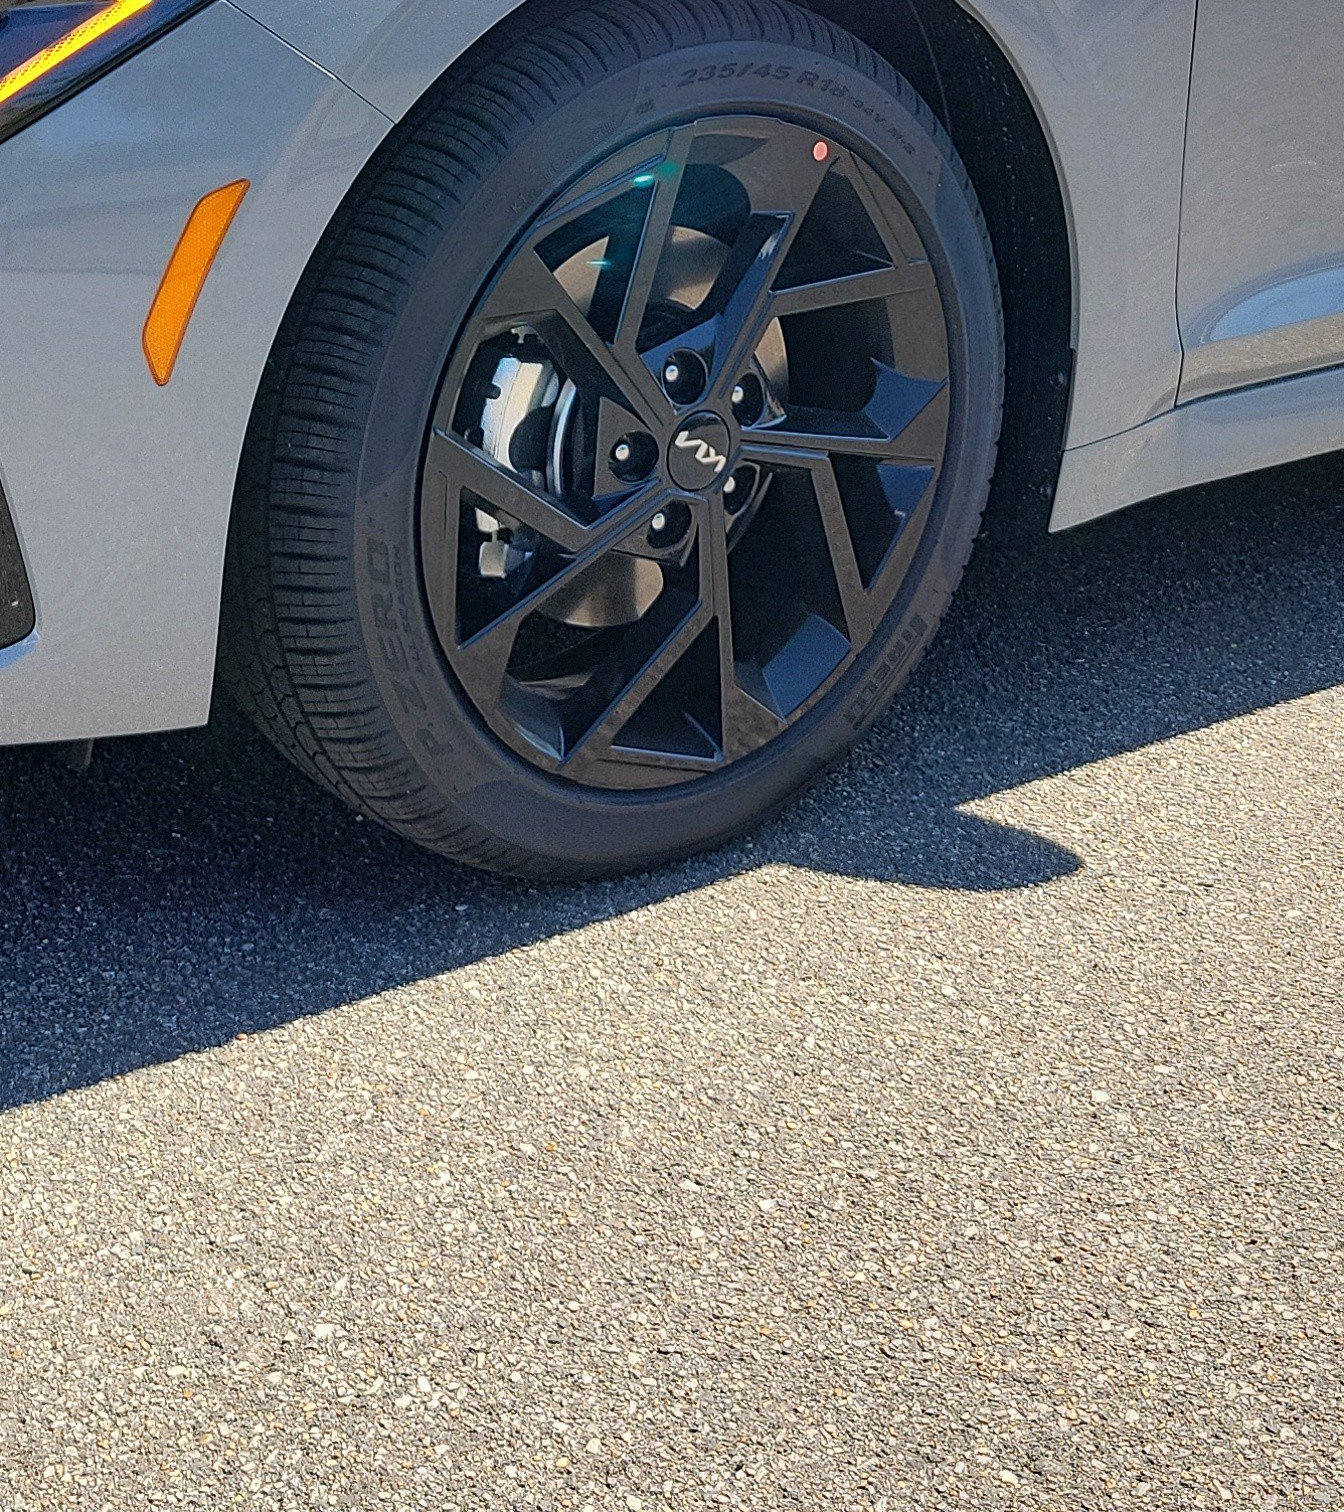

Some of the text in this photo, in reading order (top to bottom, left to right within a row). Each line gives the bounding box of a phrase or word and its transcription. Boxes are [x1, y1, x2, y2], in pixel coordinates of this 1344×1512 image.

[676, 62, 793, 88] 235/45
[796, 70, 849, 98] R18
[674, 430, 727, 473] KIA
